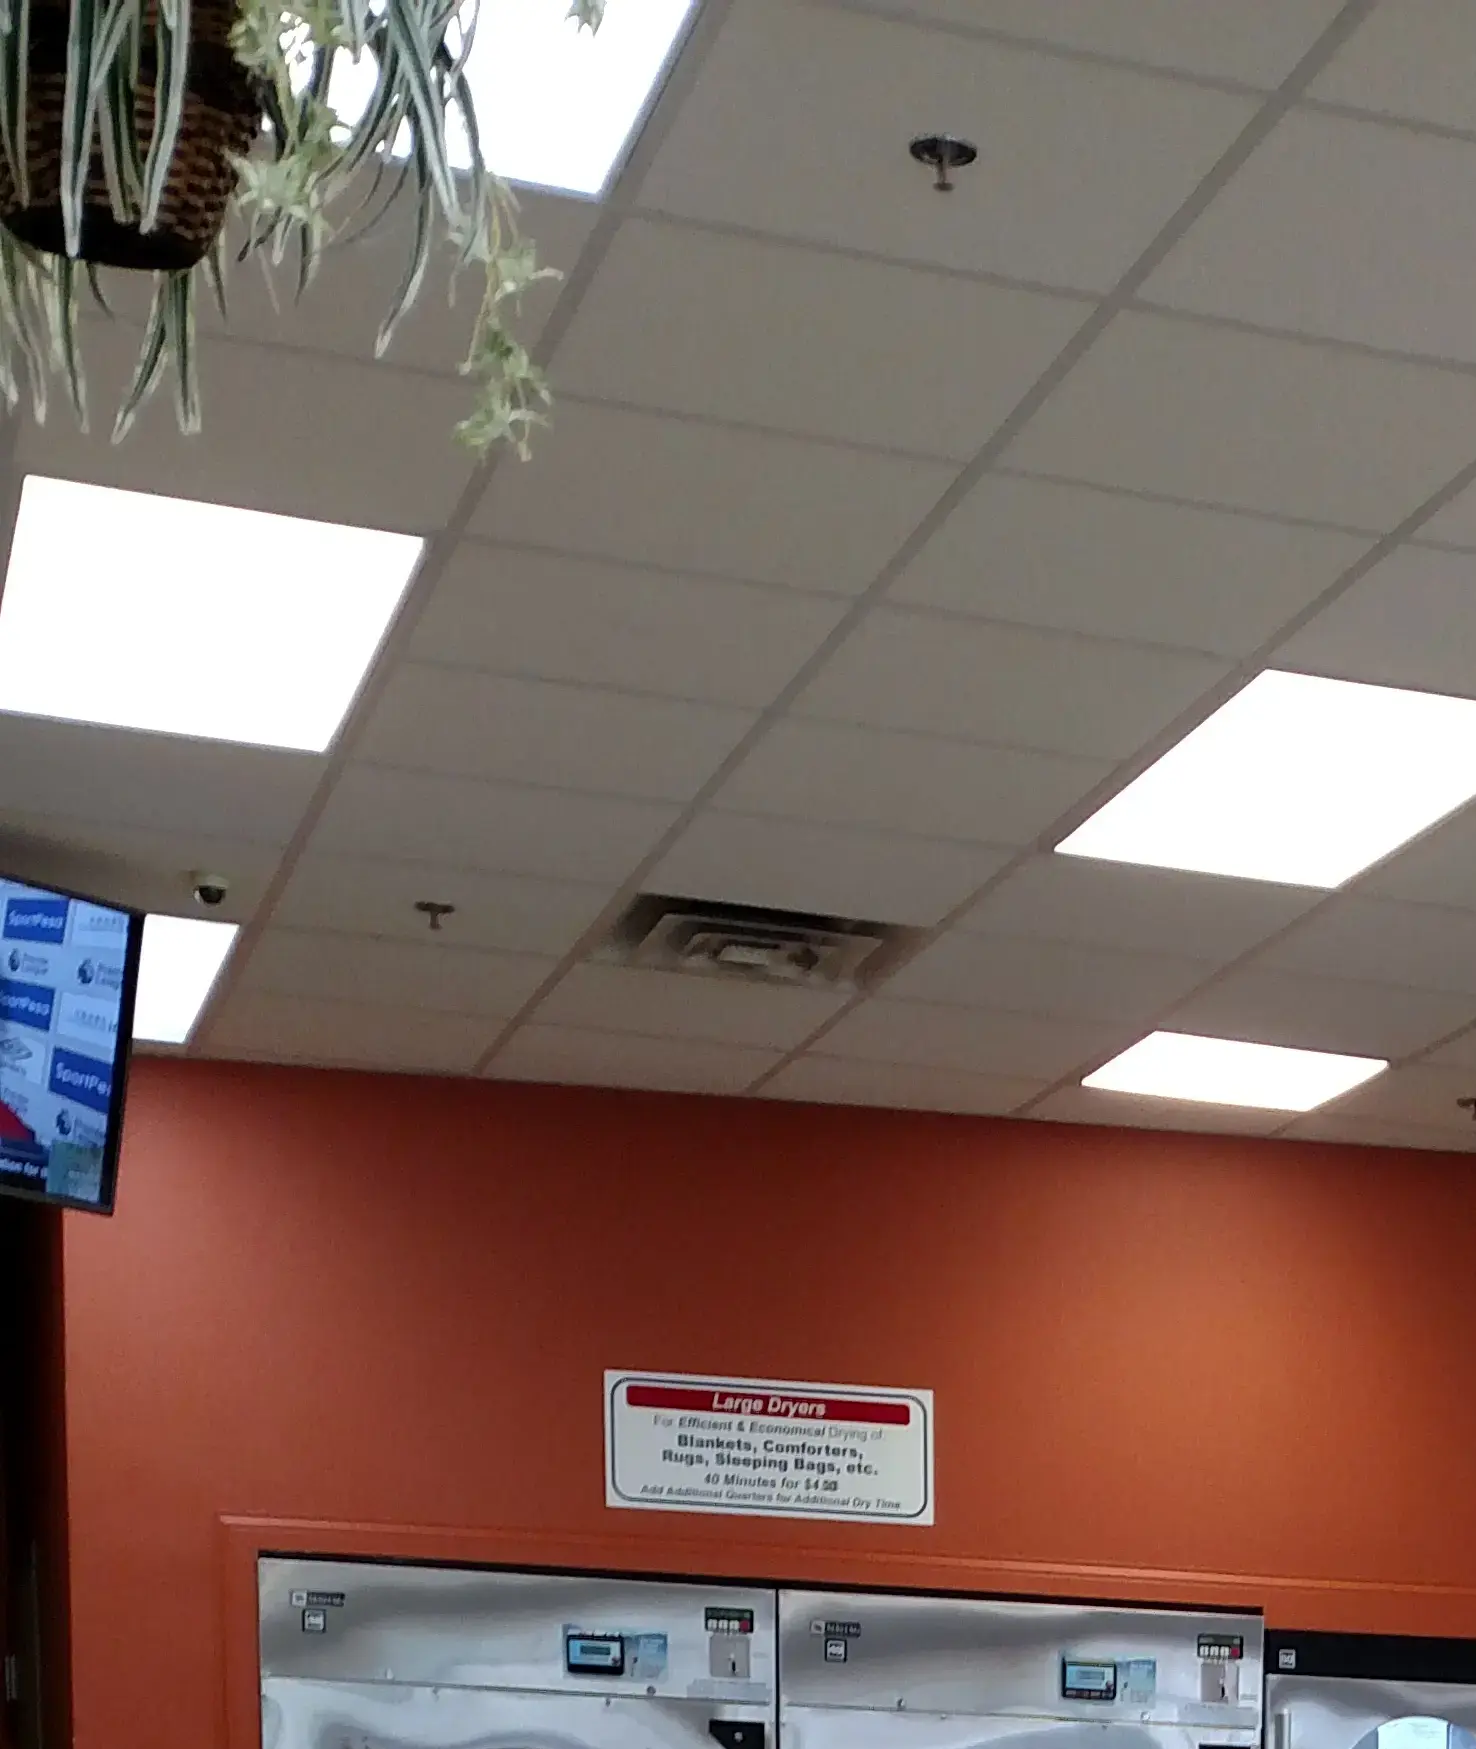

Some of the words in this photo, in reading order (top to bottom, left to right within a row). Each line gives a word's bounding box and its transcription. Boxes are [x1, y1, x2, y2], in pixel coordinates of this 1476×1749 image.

[712, 1391, 763, 1415] Large
[767, 1396, 826, 1418] Dryers
[678, 1416, 733, 1431] Efficient
[749, 1421, 825, 1438] Economical
[828, 1427, 868, 1442] Drying
[677, 1434, 757, 1454] Blankets,
[763, 1439, 864, 1460] Comforters,
[662, 1449, 709, 1467] Rugs,
[715, 1453, 788, 1472] Sleeping
[794, 1458, 841, 1475] Bags,
[846, 1461, 879, 1476] etc.
[724, 1474, 777, 1489] Minutes
[780, 1477, 800, 1490] for
